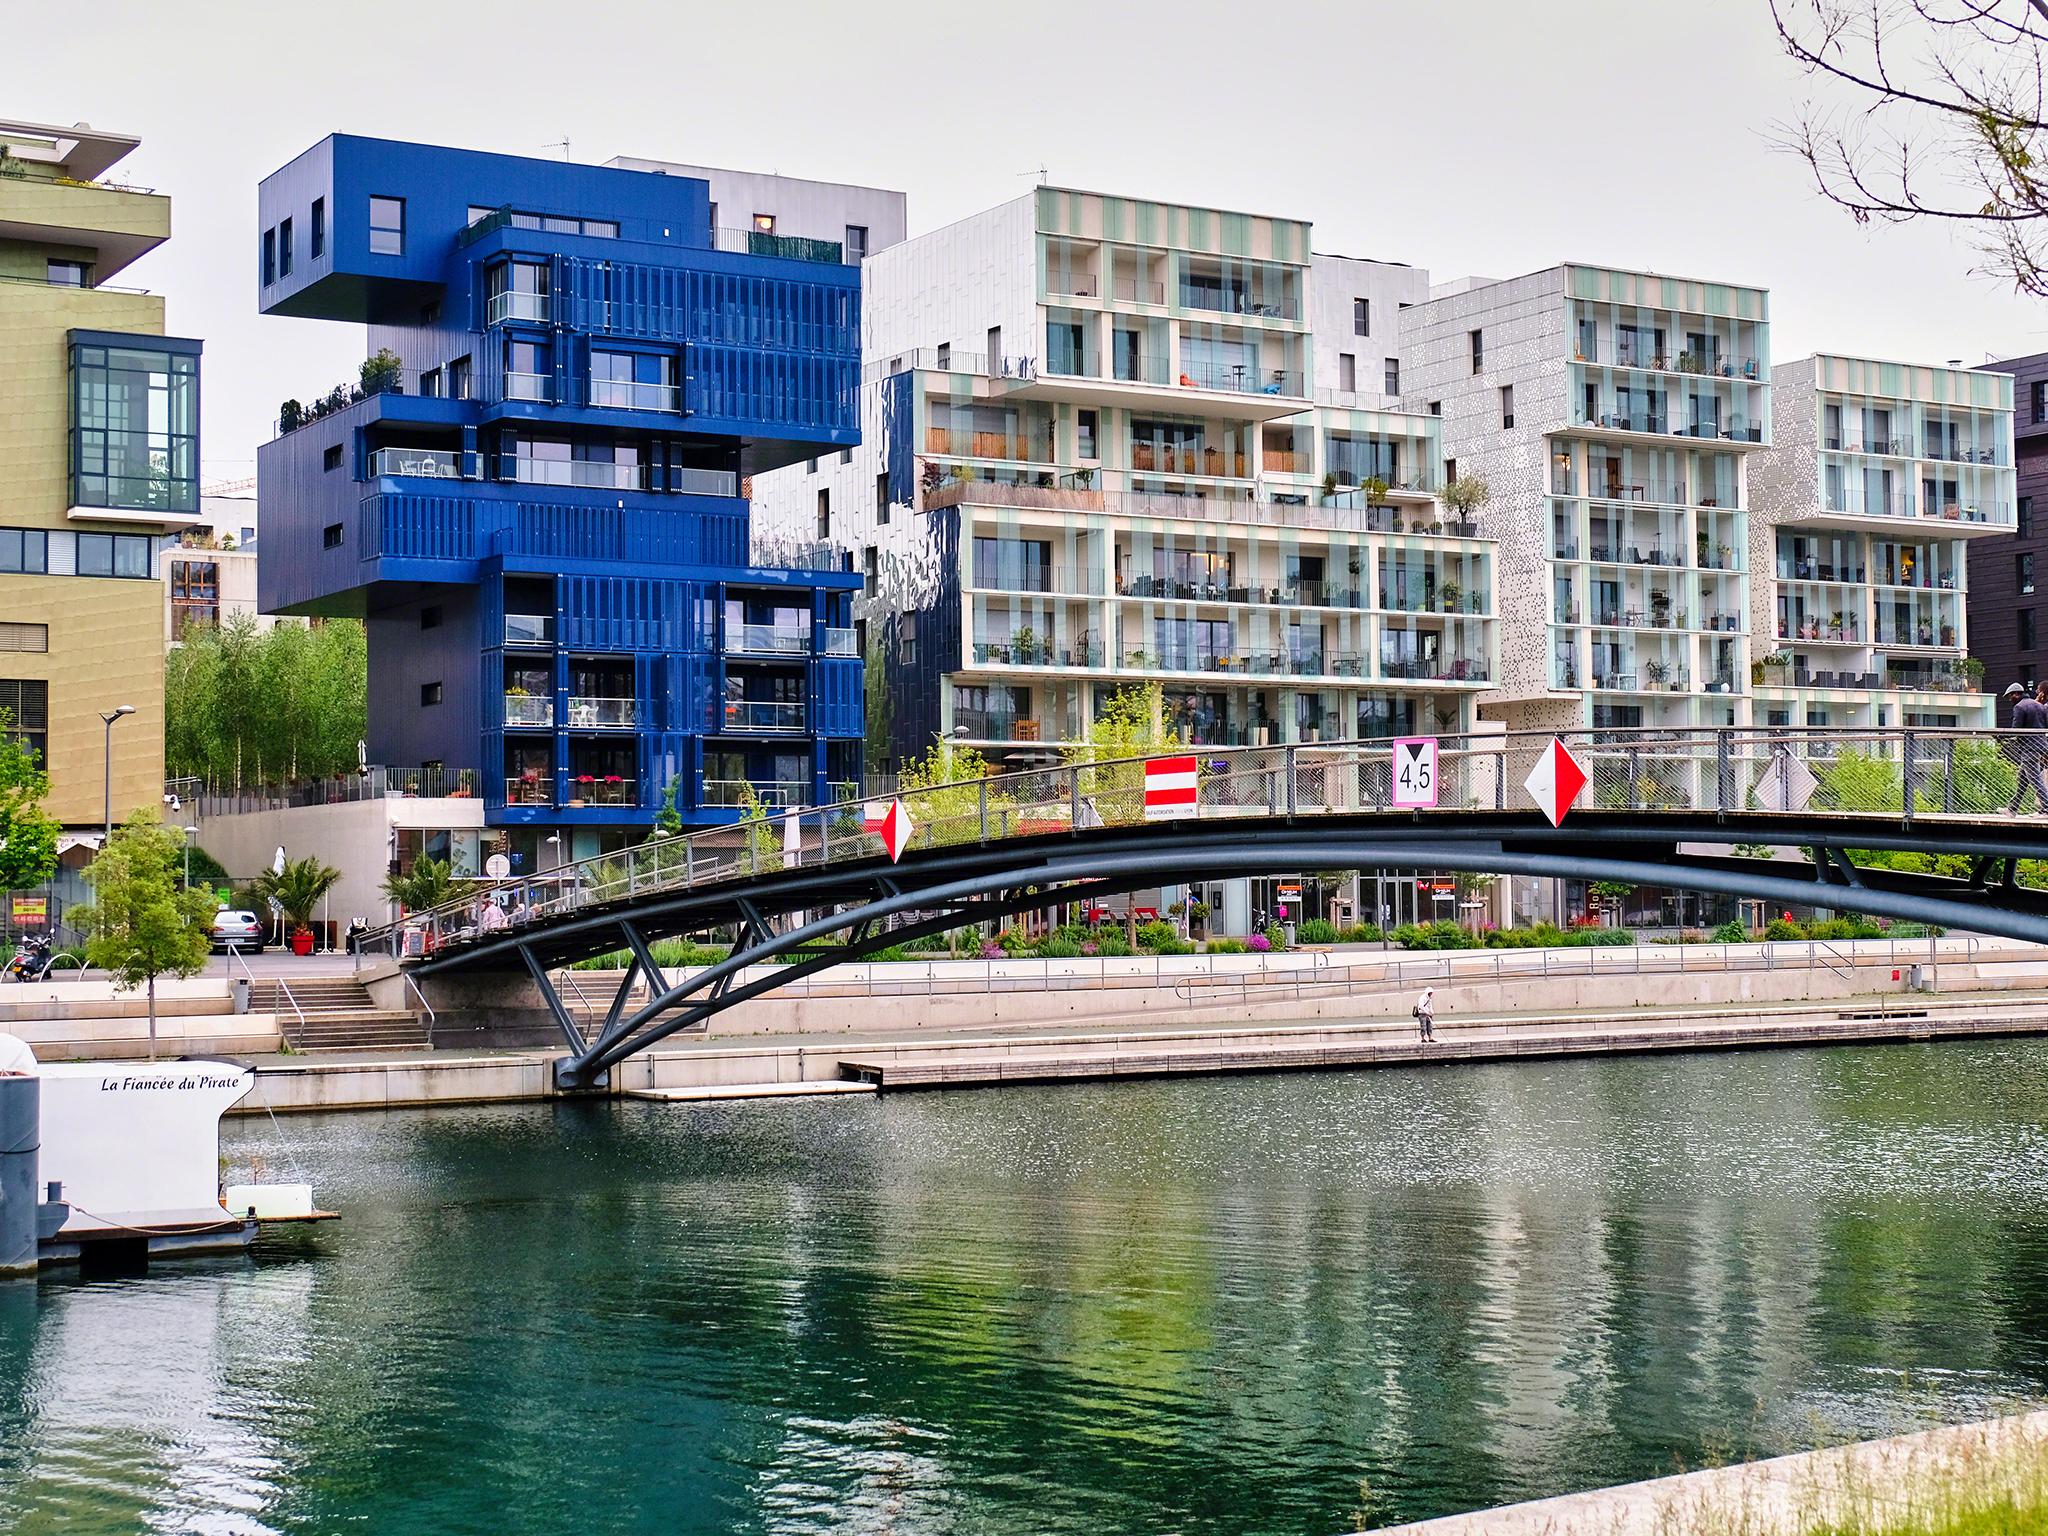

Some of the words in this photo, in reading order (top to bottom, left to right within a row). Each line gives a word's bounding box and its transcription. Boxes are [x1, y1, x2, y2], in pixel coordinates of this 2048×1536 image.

[1400, 763, 1430, 793] 4,5
[101, 1078, 118, 1091] La
[123, 1077, 175, 1091] Fiancée
[178, 1077, 195, 1090] du
[199, 1076, 239, 1089] Pirate
